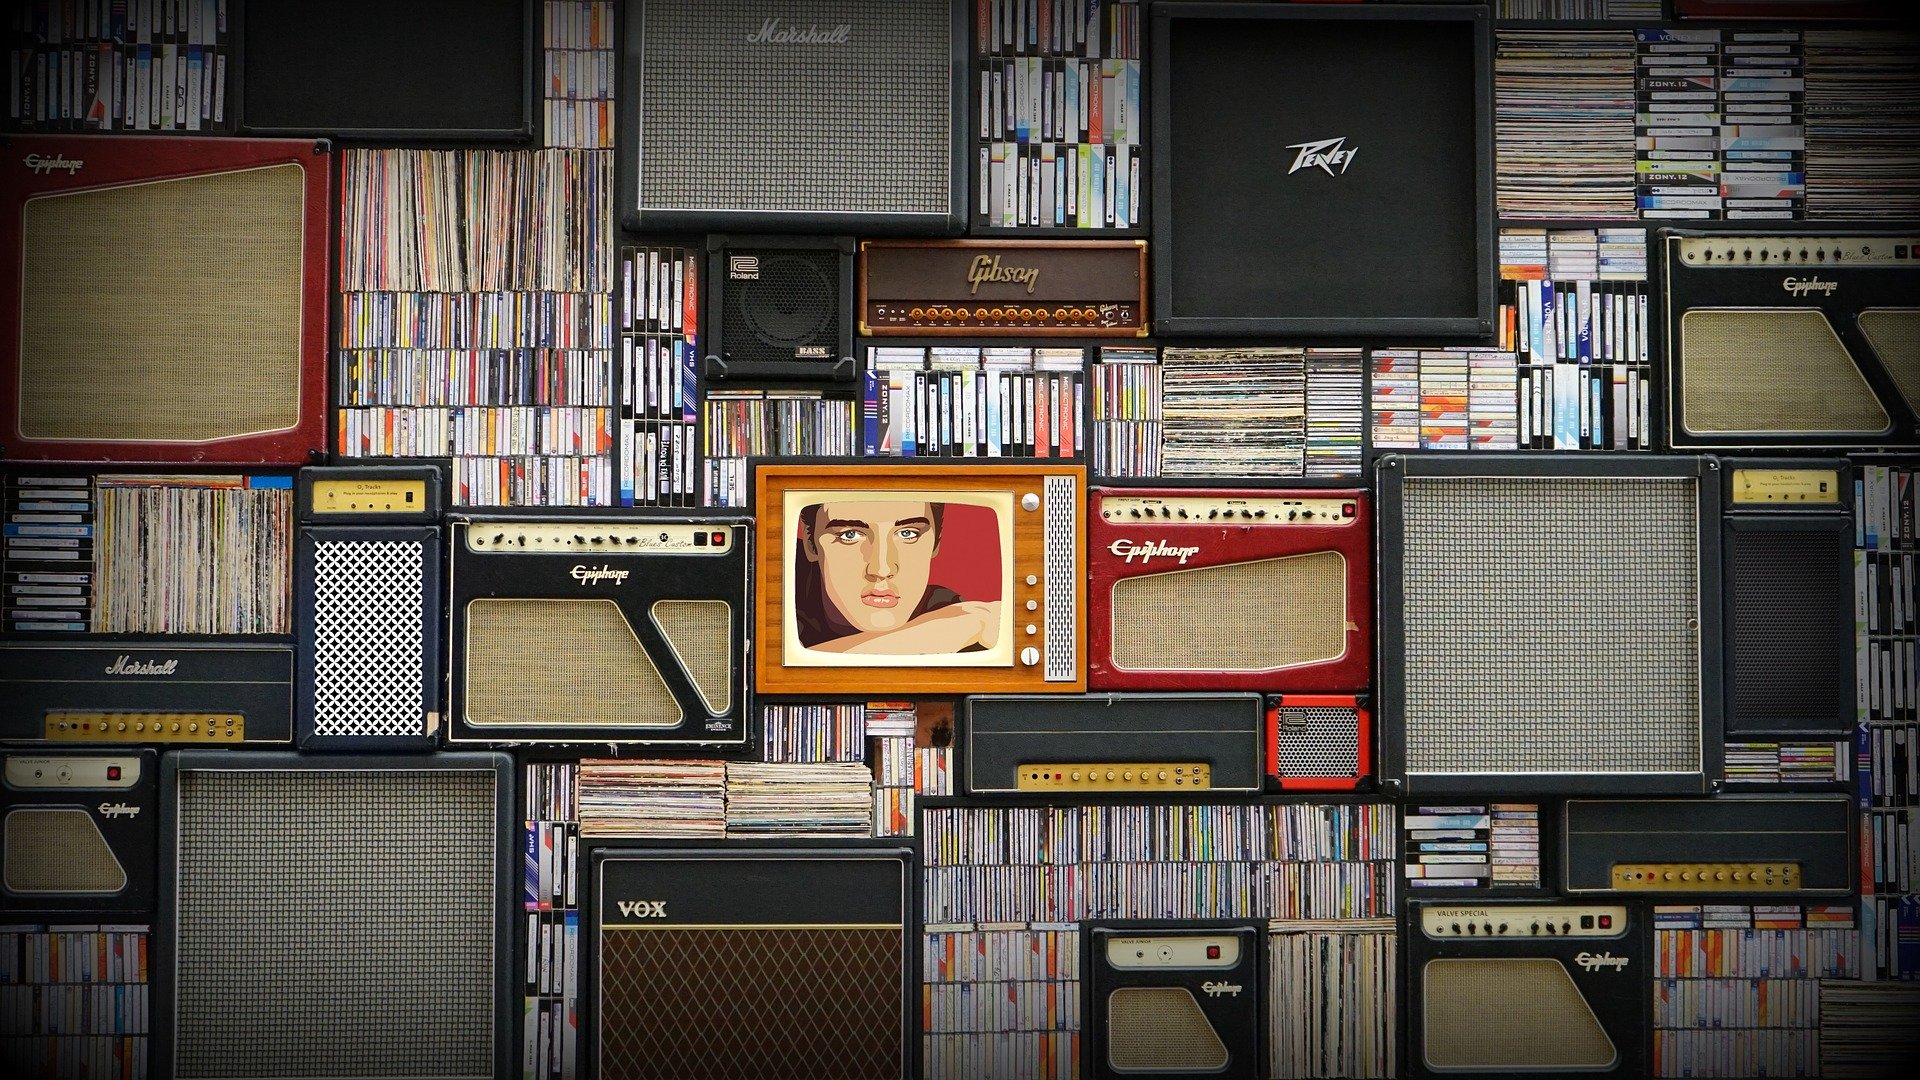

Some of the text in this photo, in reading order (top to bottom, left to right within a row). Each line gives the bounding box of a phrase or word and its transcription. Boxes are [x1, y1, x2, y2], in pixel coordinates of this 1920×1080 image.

[747, 18, 851, 44] Marshall
[88, 52, 96, 94] ZONY.12
[23, 153, 84, 175] Epiphone
[730, 272, 759, 280] Roland
[967, 254, 1039, 294] Gibson
[1783, 276, 1838, 297] Epiphone
[799, 347, 826, 355] BASS
[881, 385, 889, 424] ZONY.12
[639, 538, 692, 548] Blues Custom
[1107, 539, 1200, 564] Epiphone
[570, 564, 629, 586] Epiphone
[105, 655, 178, 675] Marshall
[617, 900, 667, 918] VOX
[1575, 952, 1629, 972] Epiphone
[1201, 981, 1243, 998] Epiphone
